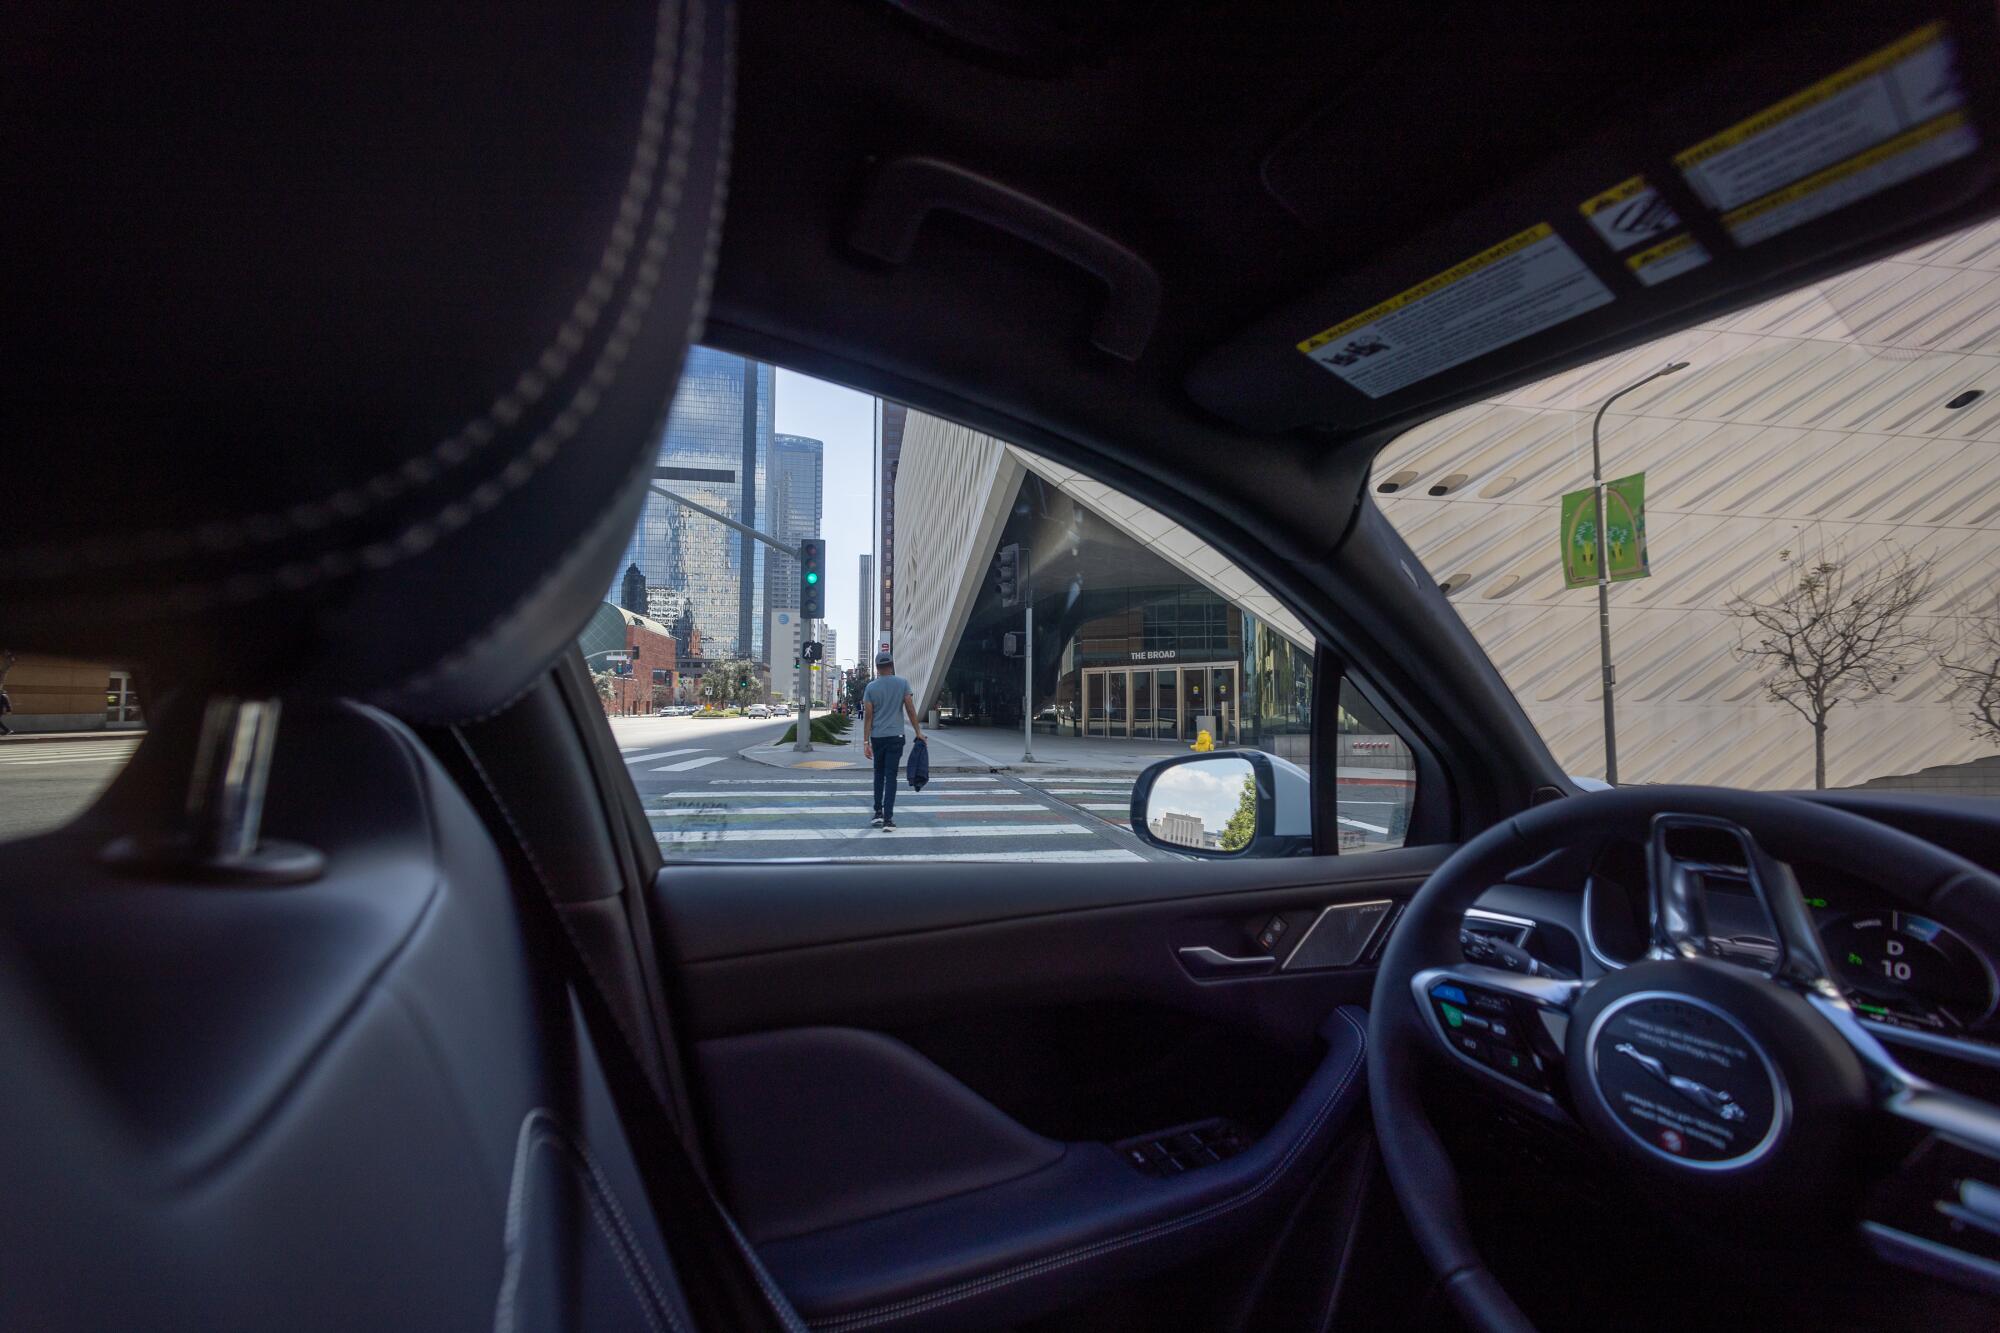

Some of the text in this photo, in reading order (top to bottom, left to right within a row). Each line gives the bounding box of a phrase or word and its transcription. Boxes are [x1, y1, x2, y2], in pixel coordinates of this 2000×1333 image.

[1131, 650, 1176, 660] THE BROAD
[1887, 940, 1904, 956] D
[1881, 960, 1911, 980] 10
